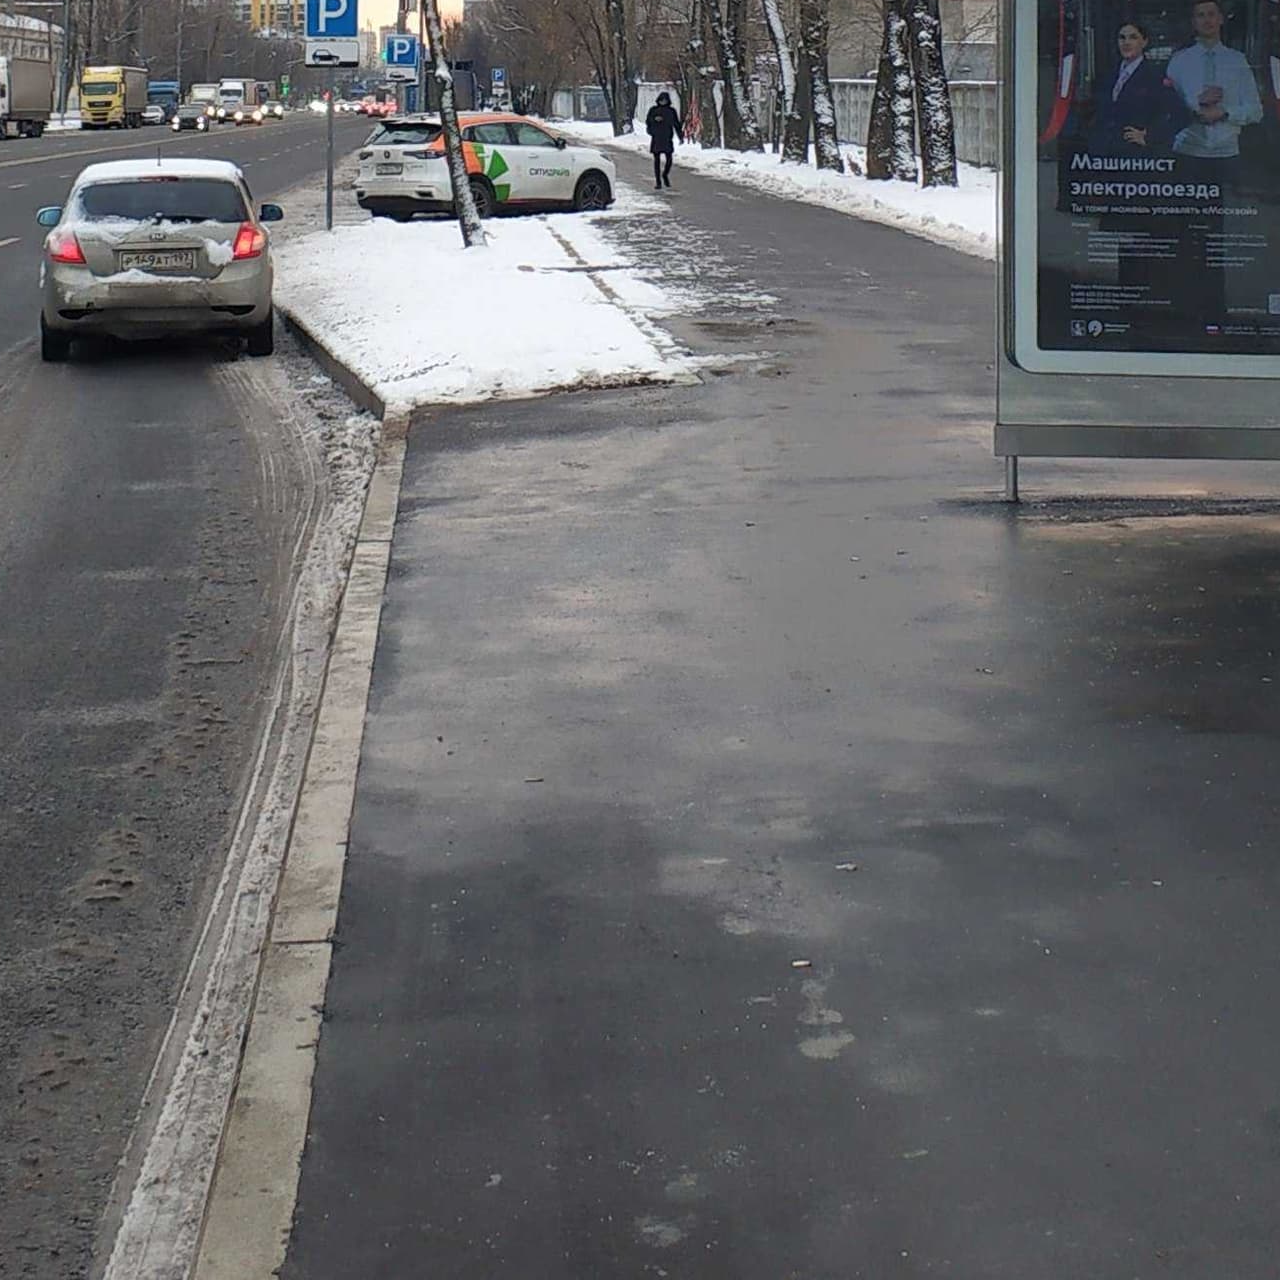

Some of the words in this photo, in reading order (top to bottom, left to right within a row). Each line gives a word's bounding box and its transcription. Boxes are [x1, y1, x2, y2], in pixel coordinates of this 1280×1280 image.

[392, 38, 410, 62] P
[1071, 153, 1175, 171] Машинист
[1071, 182, 1220, 199] электропоезда
